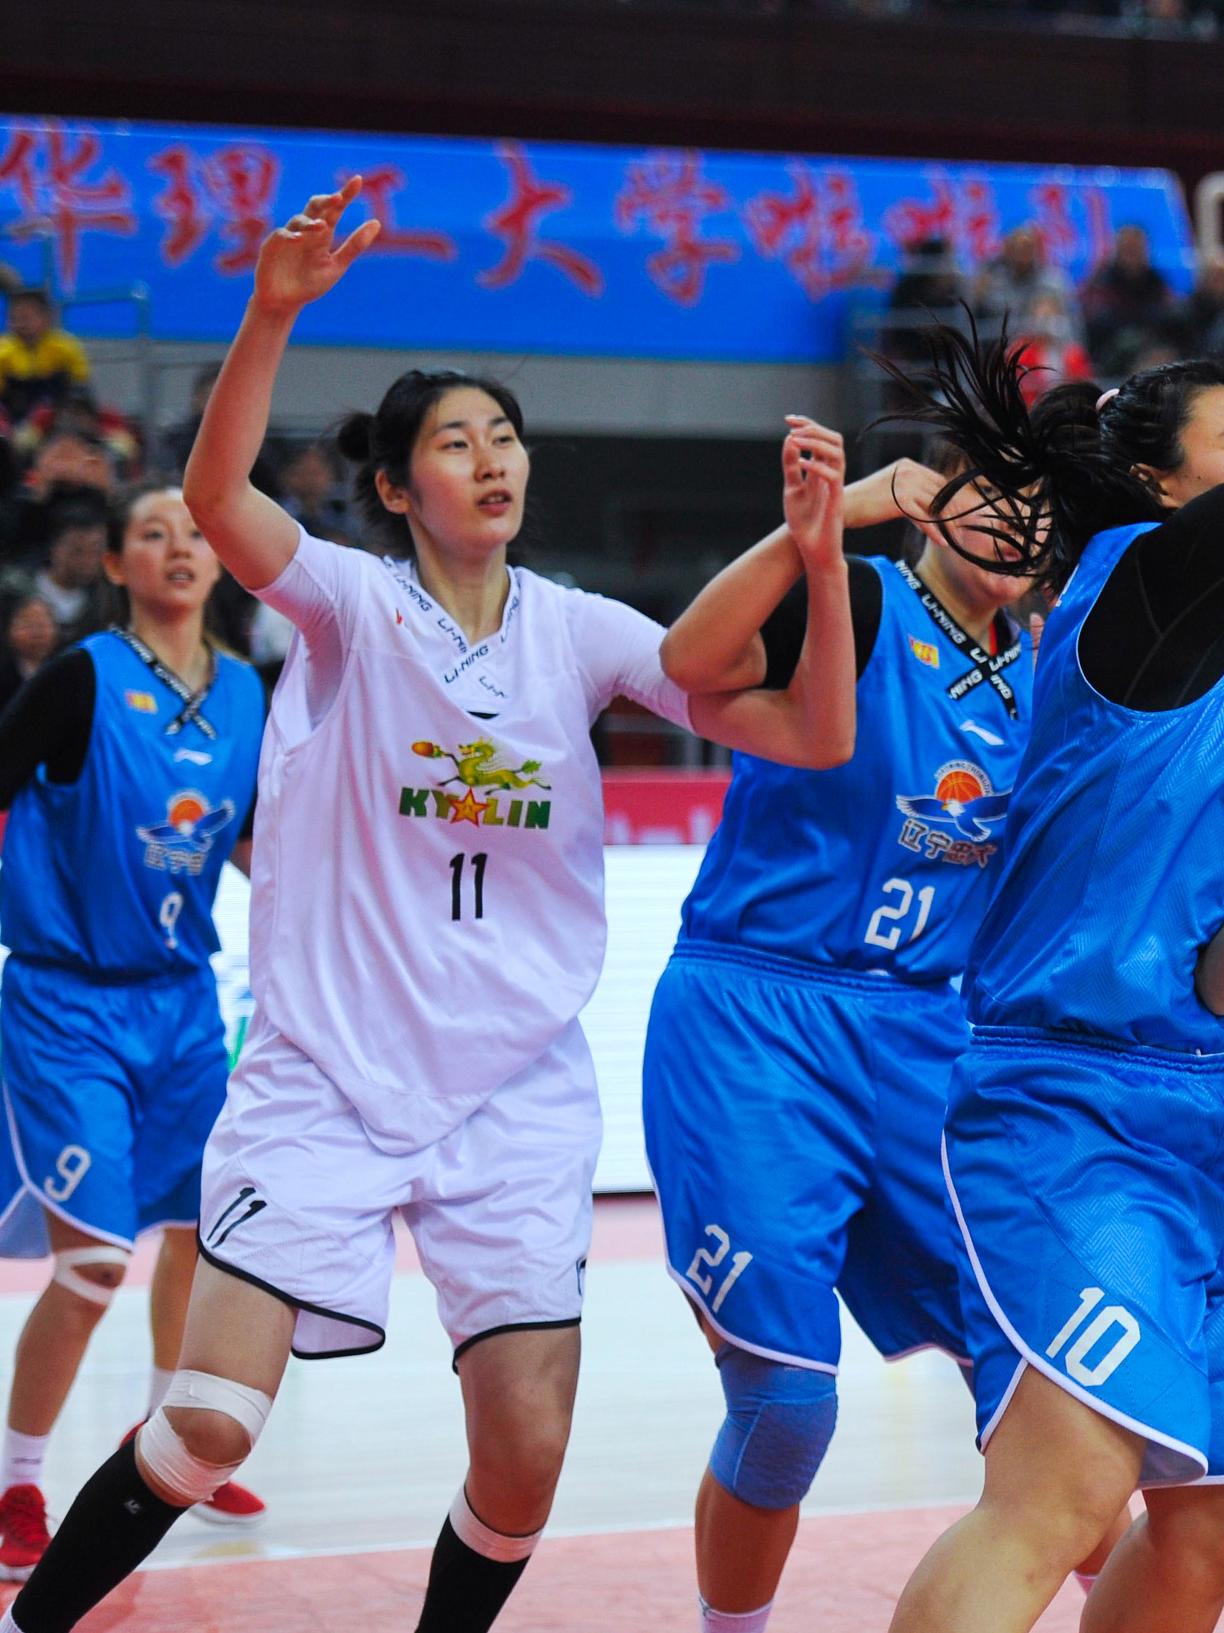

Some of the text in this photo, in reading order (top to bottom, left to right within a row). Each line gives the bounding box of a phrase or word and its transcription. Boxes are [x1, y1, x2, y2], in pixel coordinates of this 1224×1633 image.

[159, 891, 184, 950] 9
[449, 853, 487, 921] 11
[864, 878, 935, 951] 21
[44, 1144, 91, 1202] 9
[206, 1187, 267, 1249] 11
[686, 1224, 753, 1314] 21
[1045, 1287, 1141, 1387] 10
